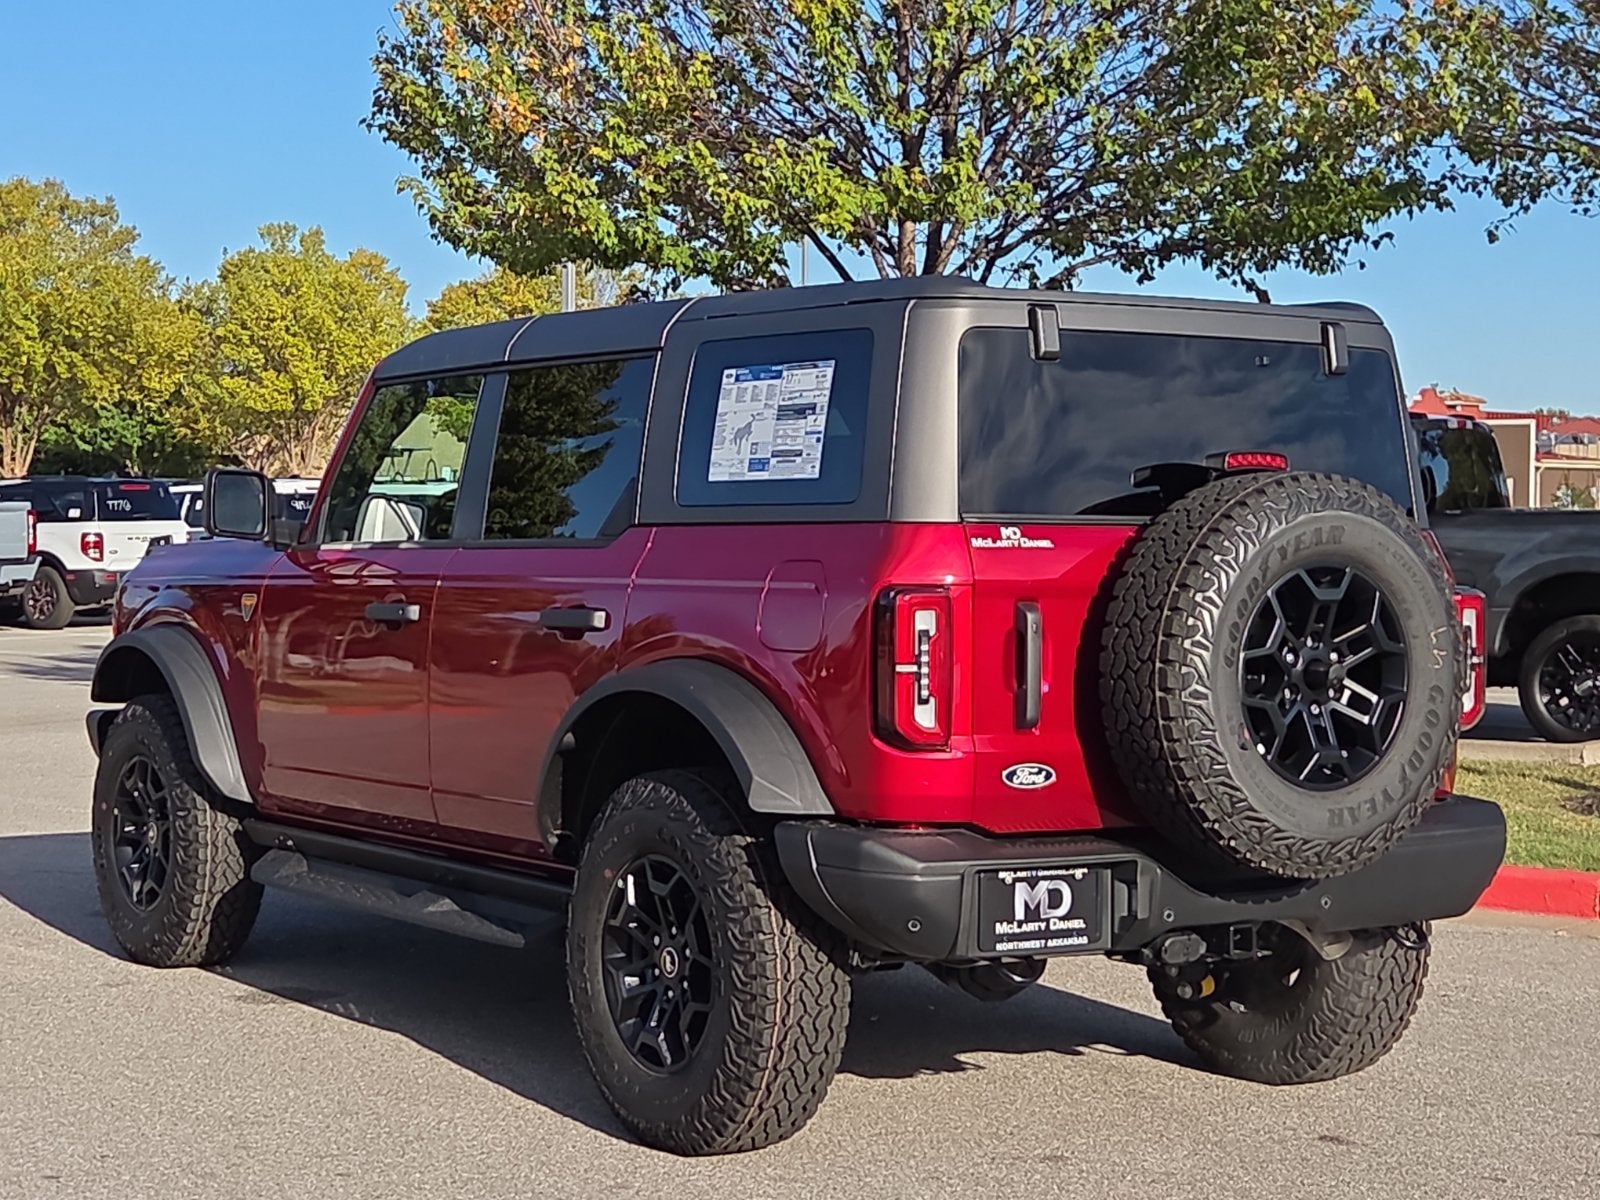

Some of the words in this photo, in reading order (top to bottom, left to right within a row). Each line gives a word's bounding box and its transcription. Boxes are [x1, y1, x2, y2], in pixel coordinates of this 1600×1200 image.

[1000, 526, 1021, 539] MD
[1014, 879, 1073, 921] MD
[995, 940, 1046, 952] NORTHWEST
[1047, 935, 1089, 948] ARKANSAS
